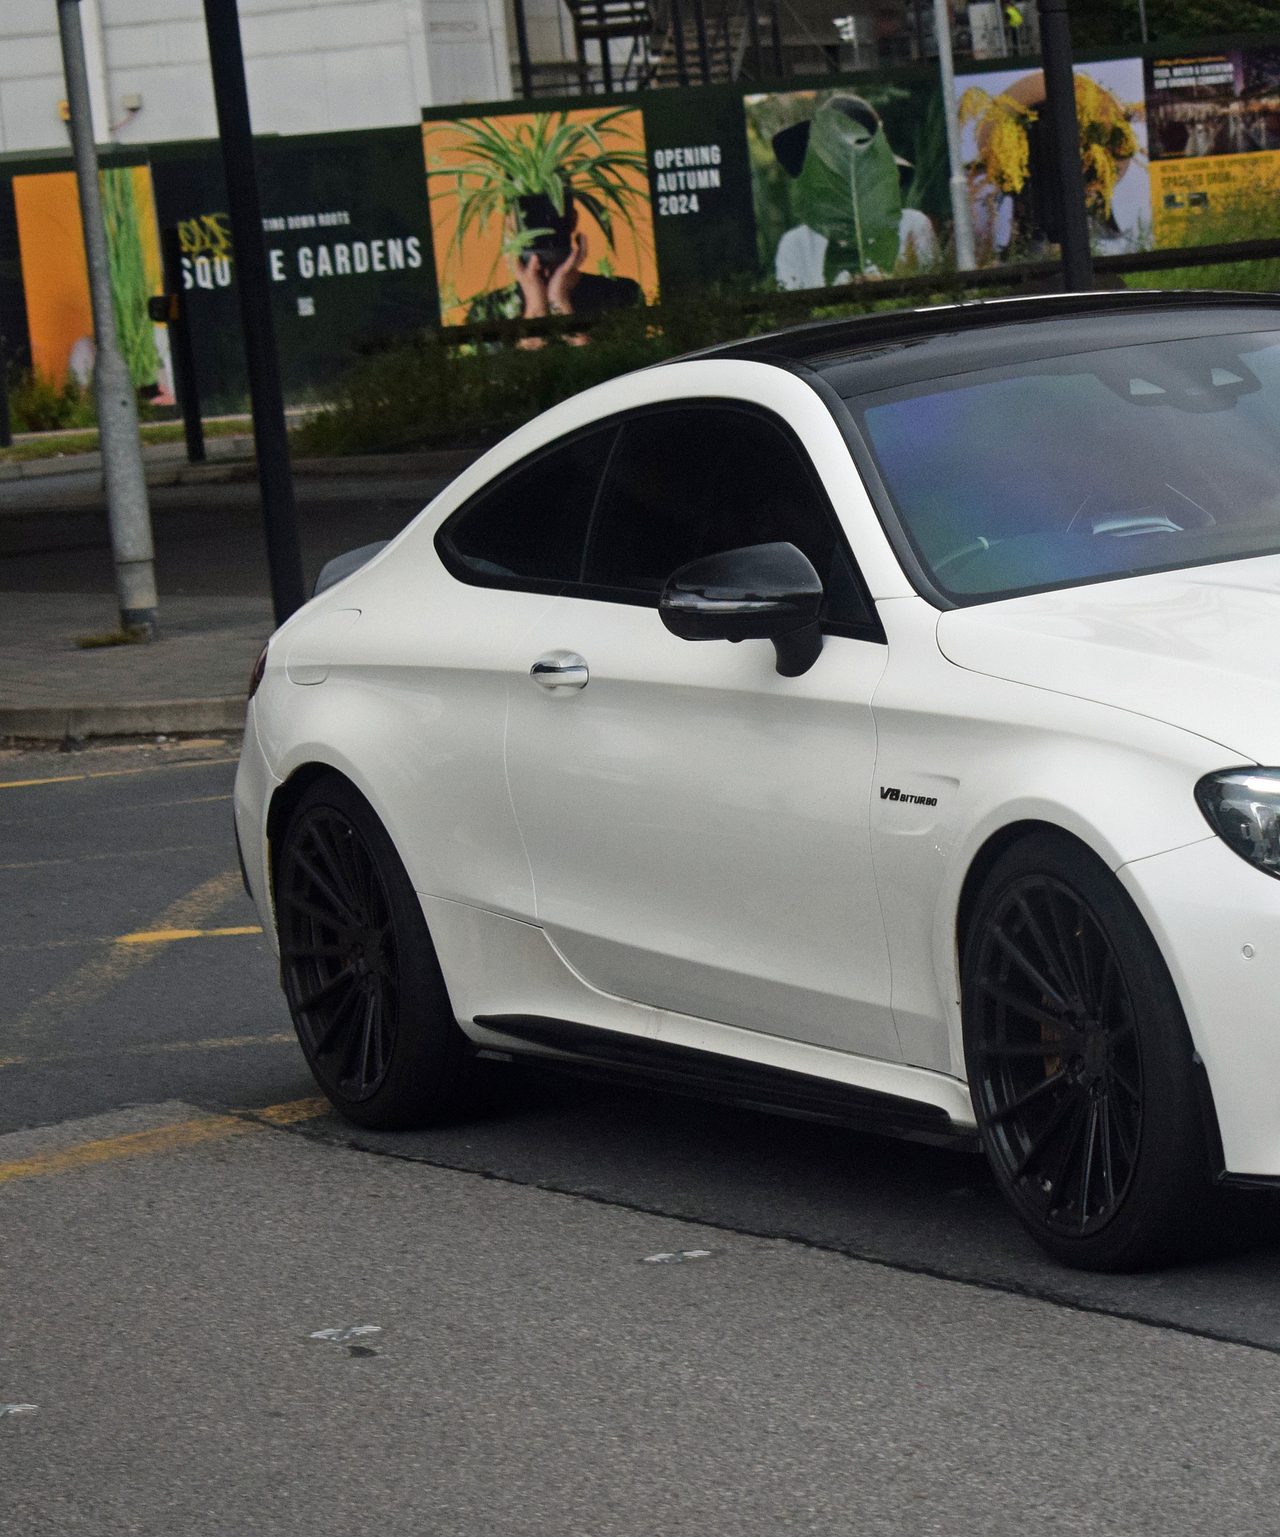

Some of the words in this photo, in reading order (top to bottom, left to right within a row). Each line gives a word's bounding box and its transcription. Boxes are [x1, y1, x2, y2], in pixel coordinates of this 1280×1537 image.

[654, 144, 722, 169] OPENING
[656, 167, 721, 192] AUTUMN
[658, 193, 699, 215] 2024
[317, 211, 351, 227] ROOTS
[181, 249, 287, 290] SQUE
[297, 235, 423, 279] GARDENS
[880, 786, 901, 801] V8
[900, 793, 938, 807] BITURBO
